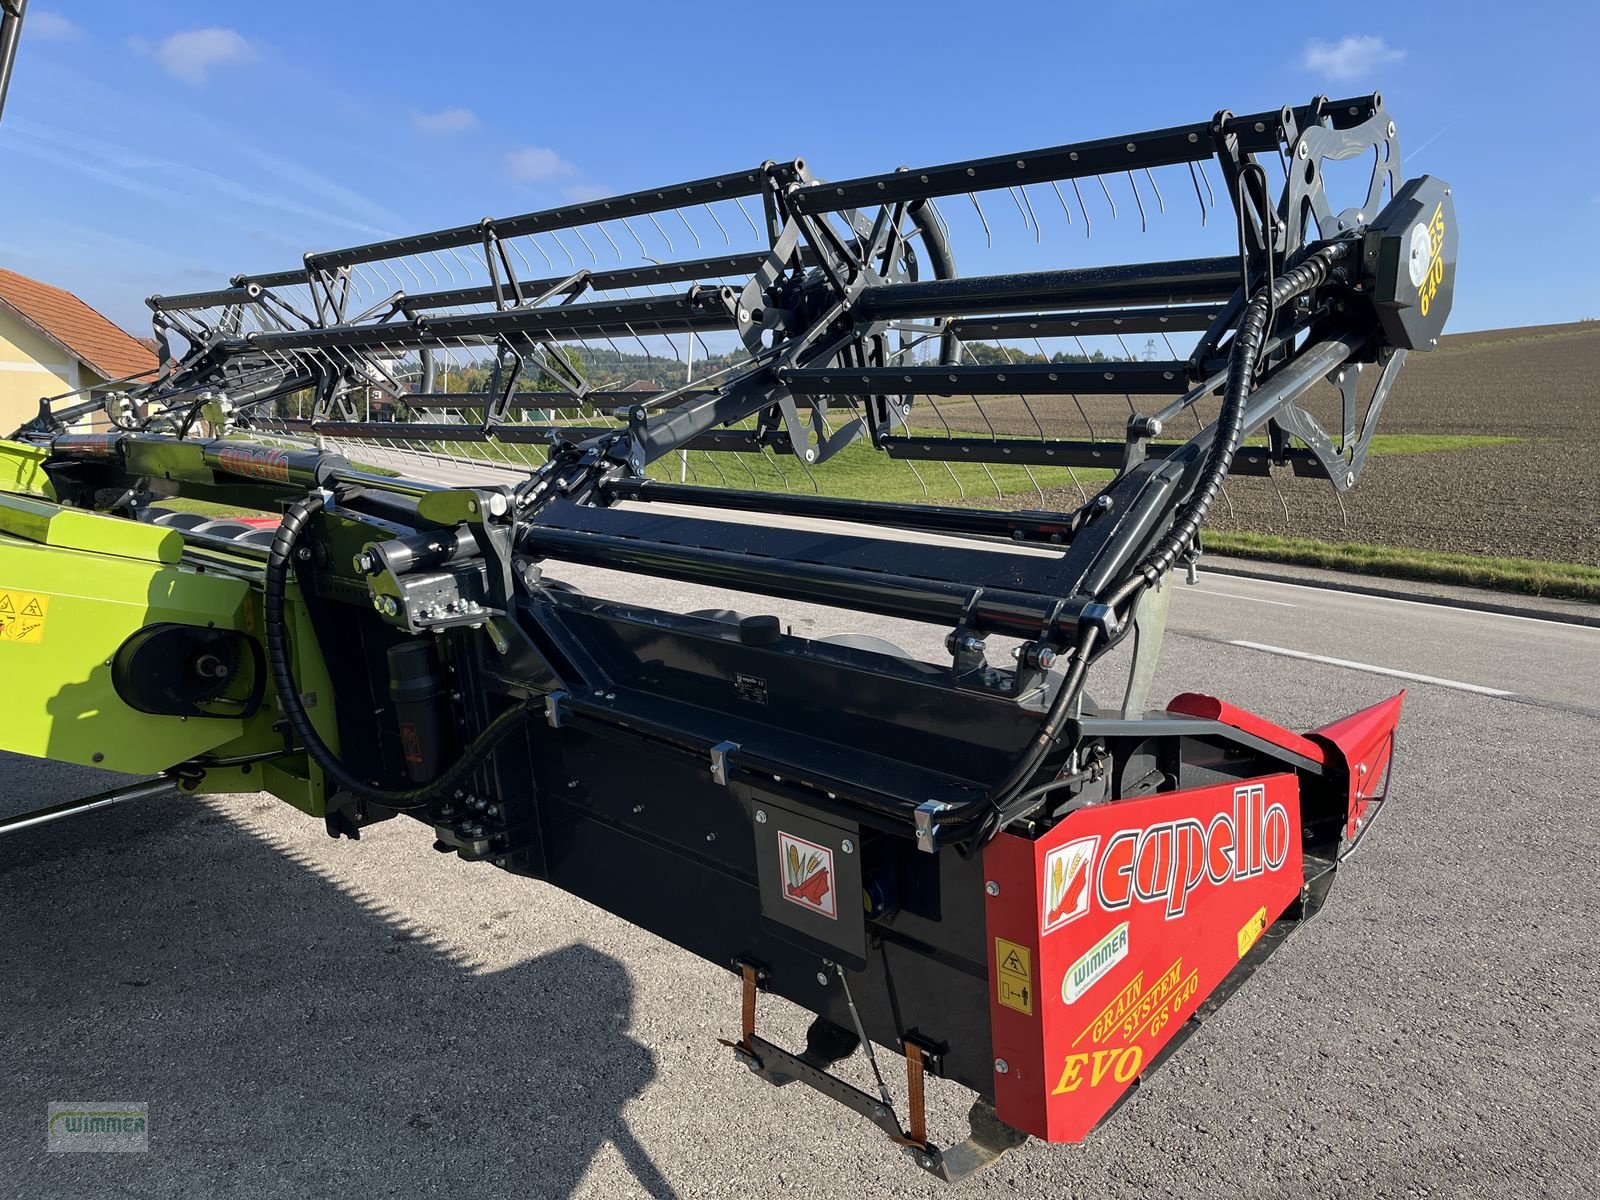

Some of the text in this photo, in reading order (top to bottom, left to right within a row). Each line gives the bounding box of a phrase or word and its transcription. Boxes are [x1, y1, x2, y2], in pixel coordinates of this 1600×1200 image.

[1429, 210, 1445, 257] GS
[1421, 256, 1443, 316] 640
[1098, 785, 1288, 919] capello
[1073, 929, 1127, 988] WIMMER
[1091, 976, 1144, 1044] GRAIN
[1123, 961, 1183, 1040] SYSTEM
[1151, 974, 1199, 1038] GS 640
[1051, 1045, 1143, 1096] EVO
